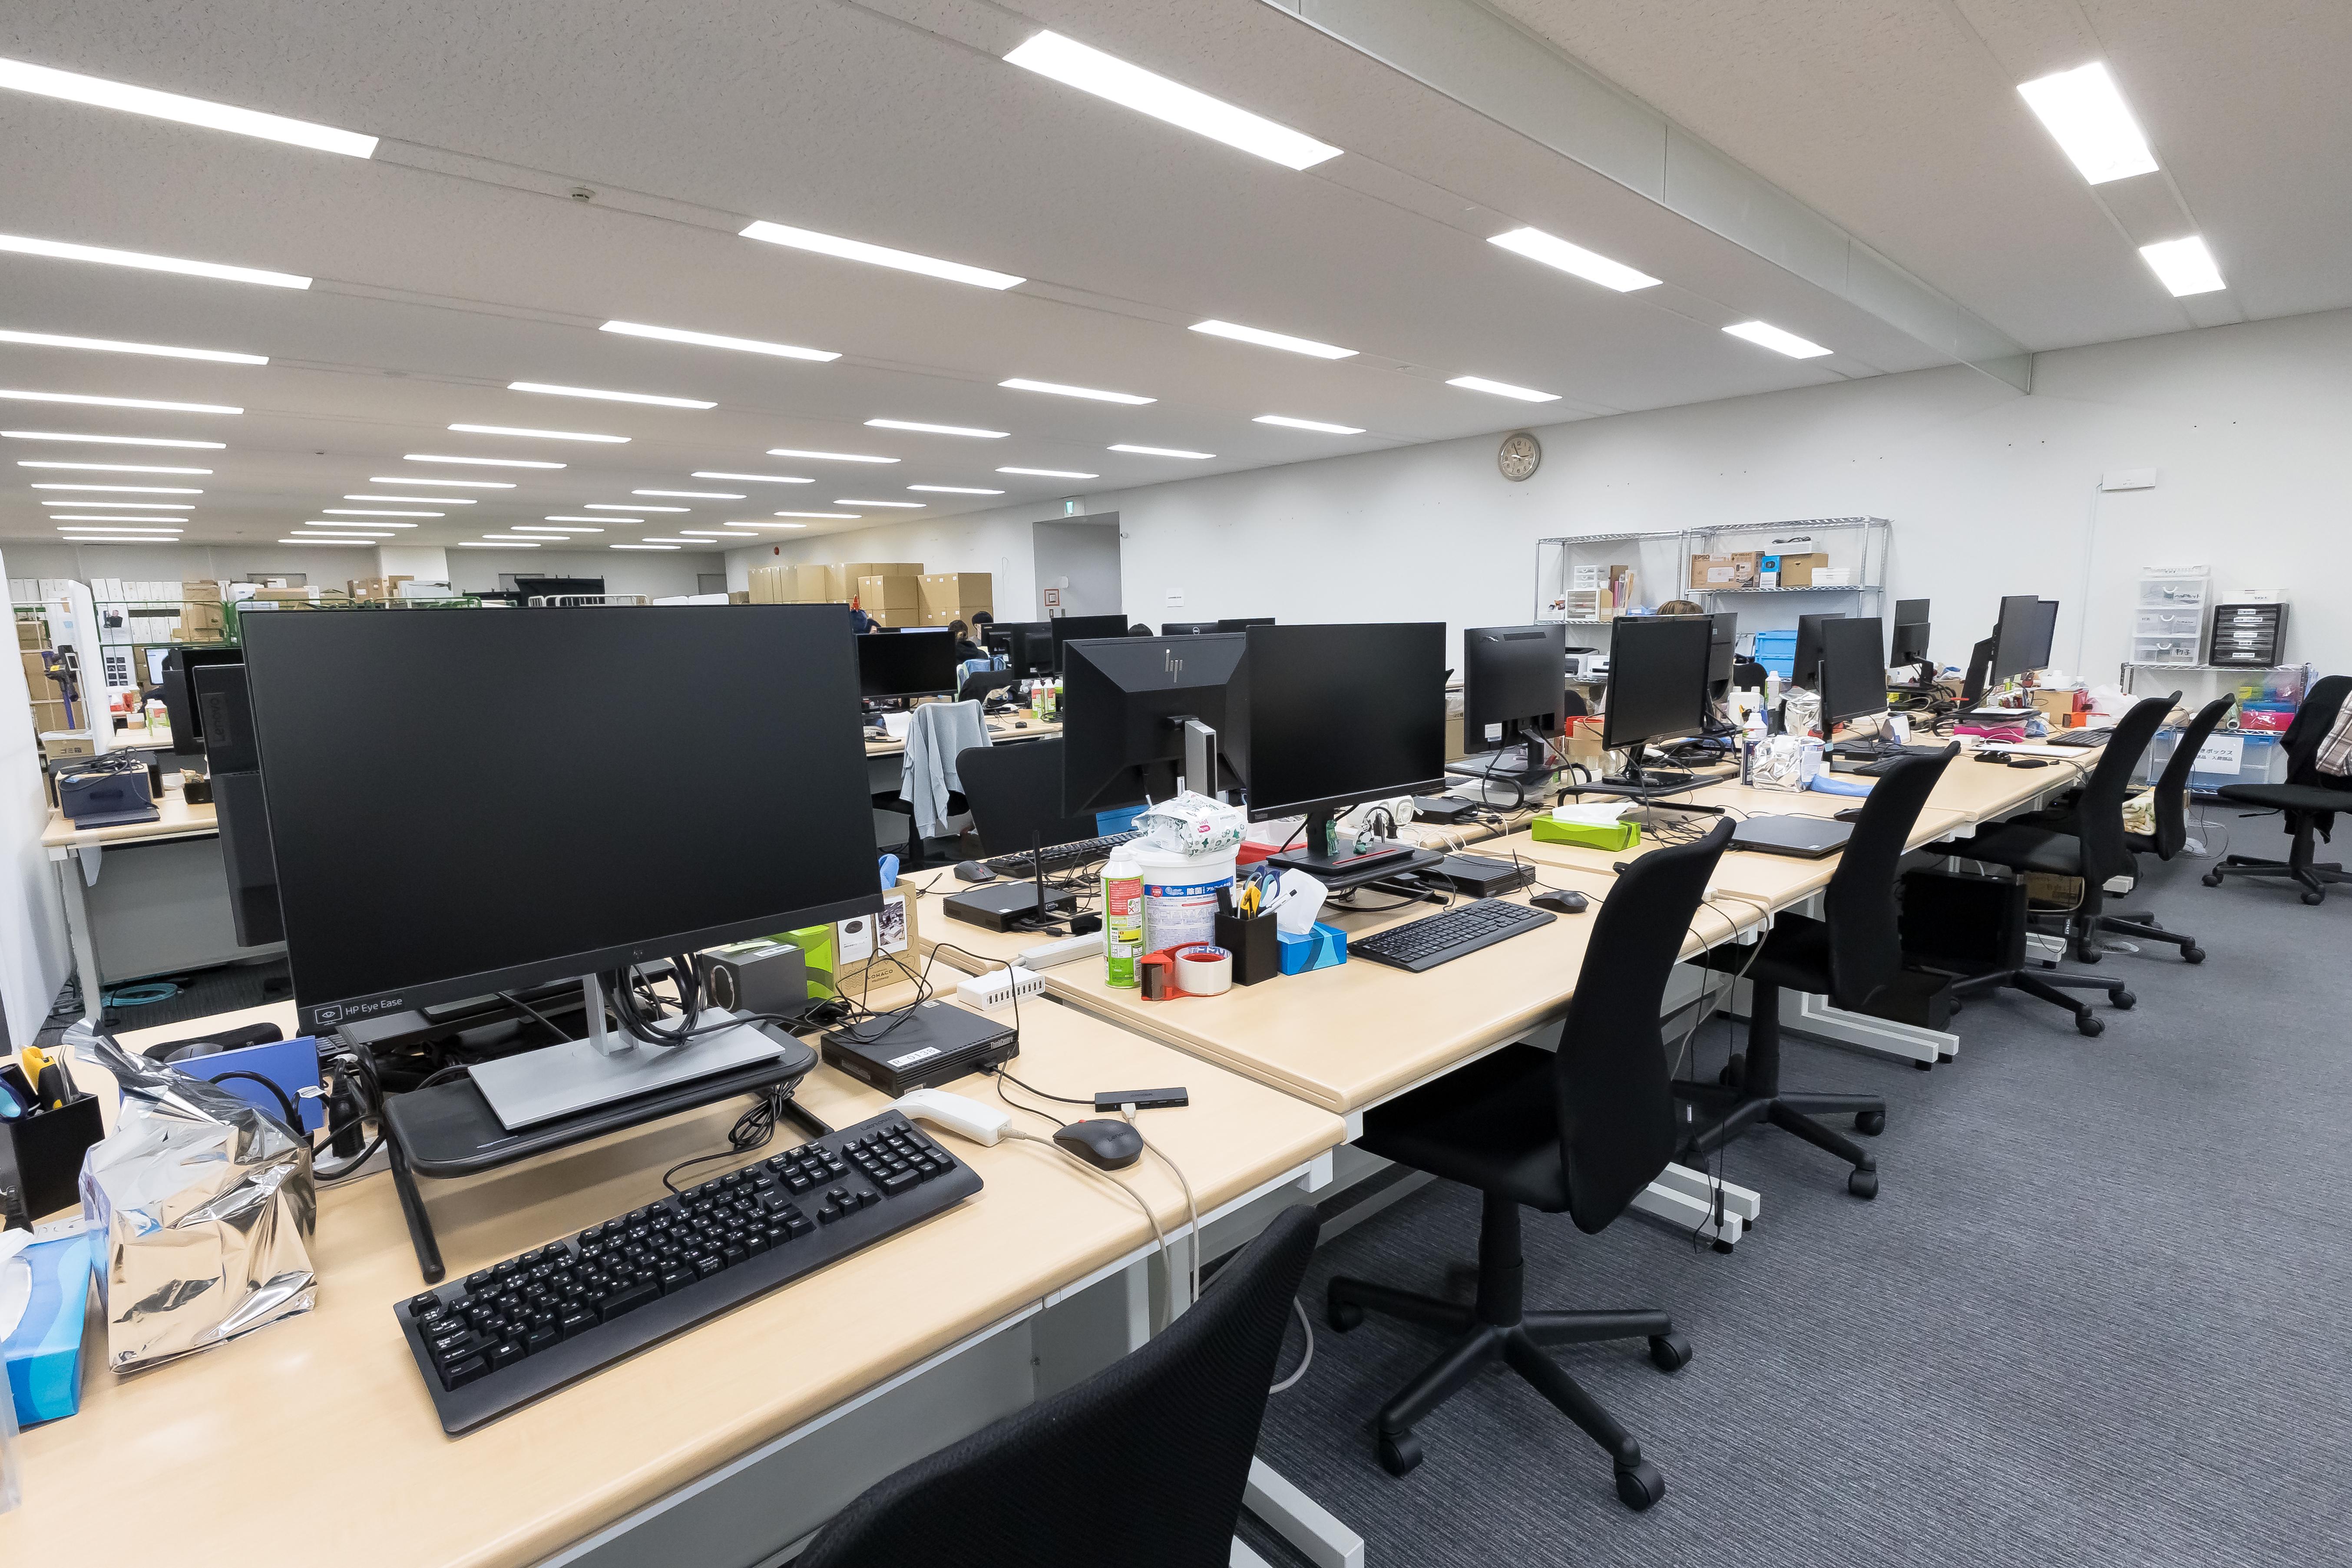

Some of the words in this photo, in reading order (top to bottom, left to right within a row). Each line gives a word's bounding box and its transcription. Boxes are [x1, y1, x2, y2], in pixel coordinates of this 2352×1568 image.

[1165, 649, 1183, 683] hp
[346, 1006, 359, 1015] HP
[361, 1003, 378, 1013] Eye
[380, 999, 402, 1008] Ease
[893, 1048, 935, 1065] R-0138
[860, 1117, 893, 1131] Lenovo
